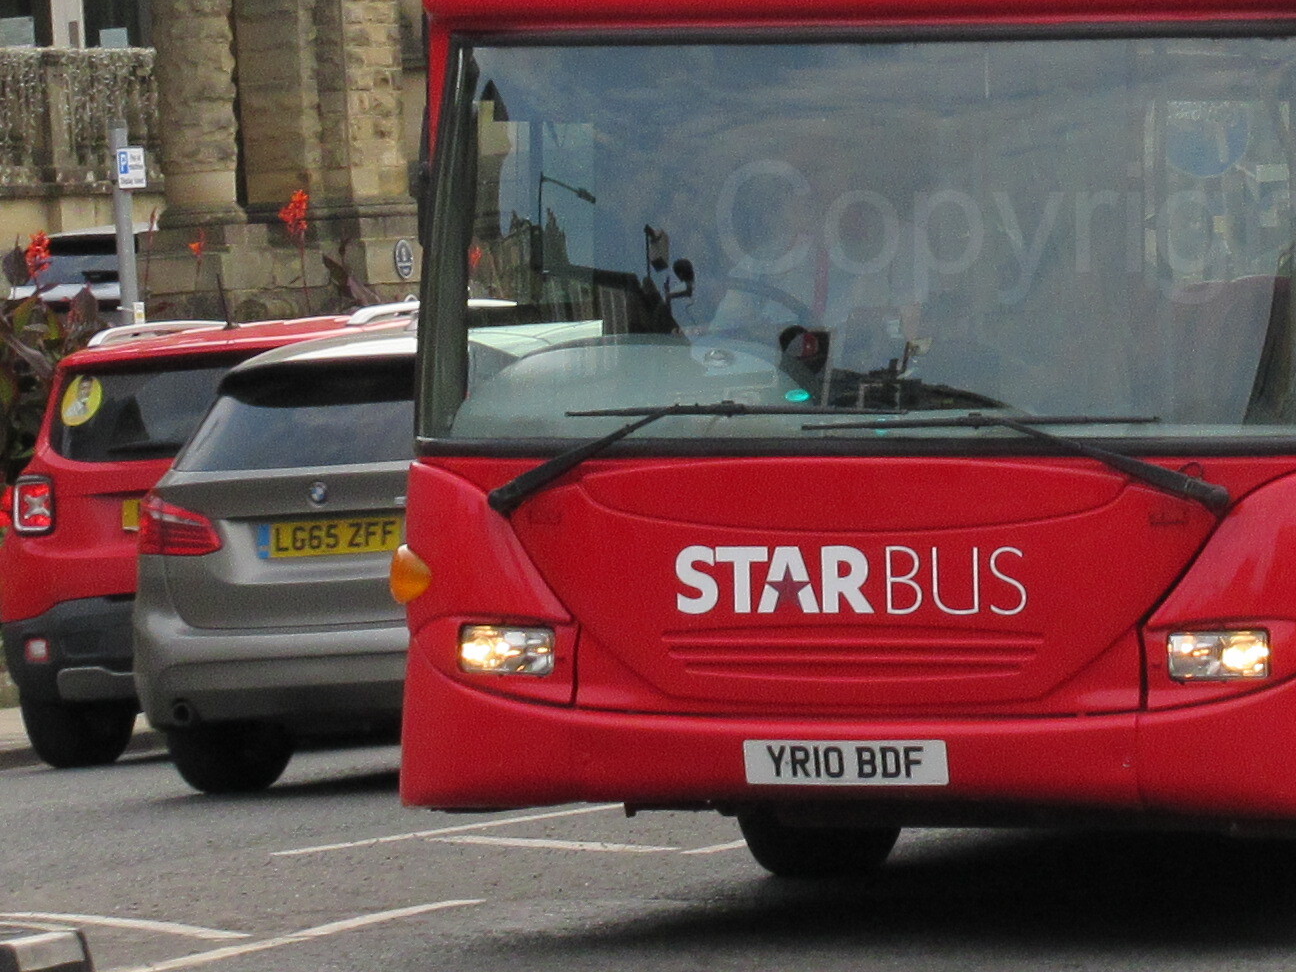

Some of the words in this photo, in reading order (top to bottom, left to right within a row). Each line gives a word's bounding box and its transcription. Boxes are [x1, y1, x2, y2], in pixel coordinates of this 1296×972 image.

[275, 524, 339, 552] LG65
[347, 520, 396, 548] ZFF
[766, 745, 844, 778] YR10
[856, 746, 924, 779] BDF
